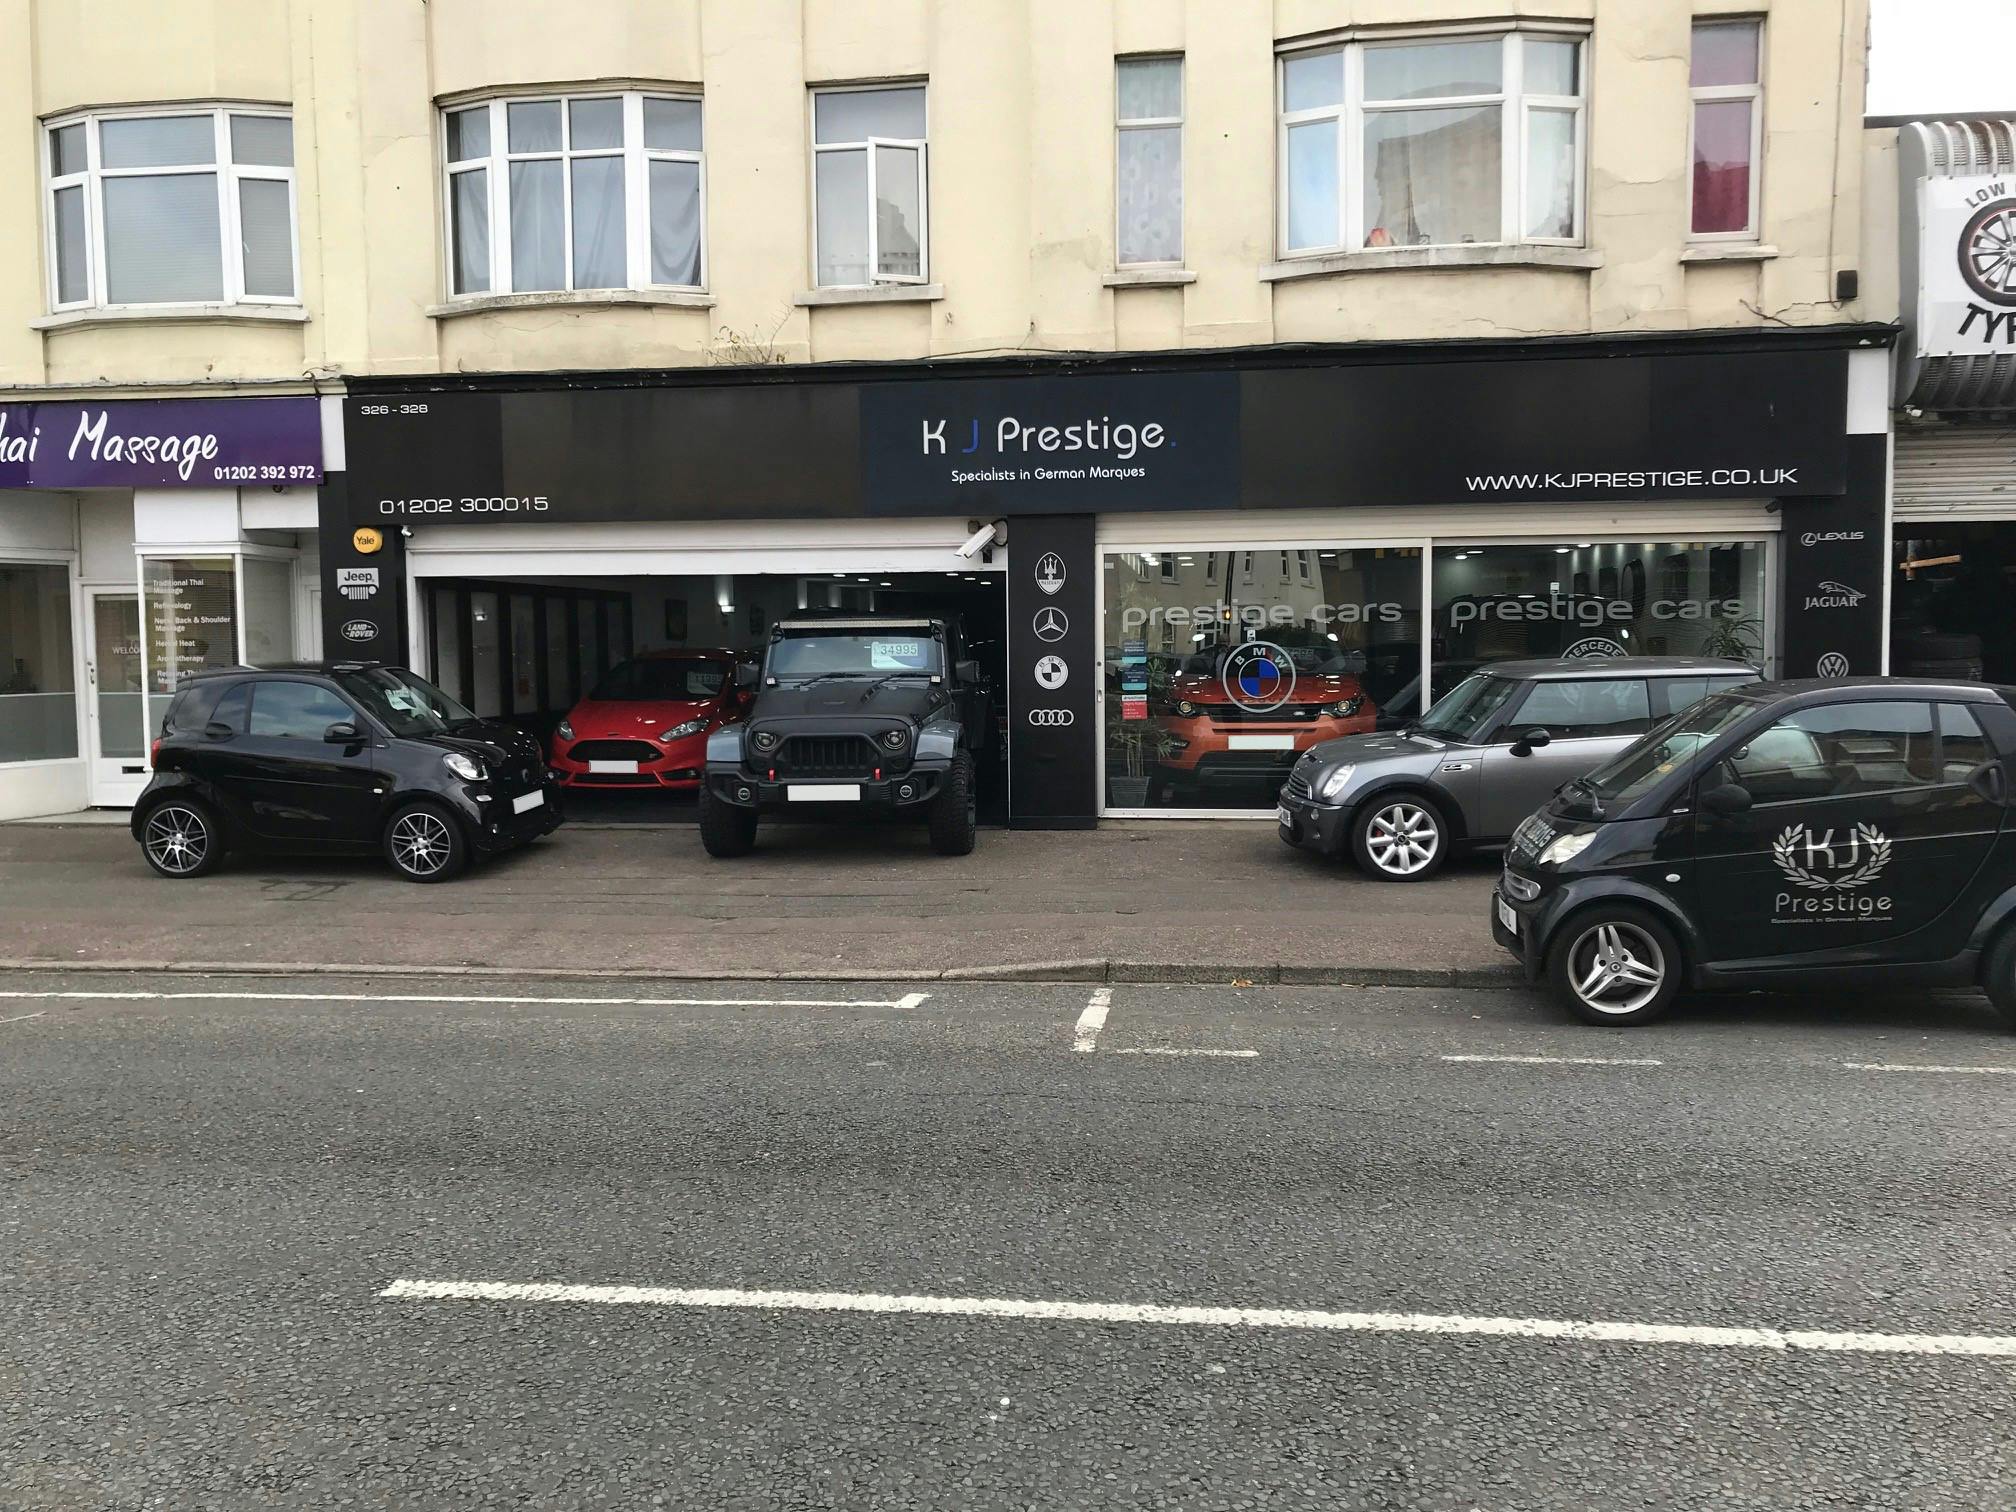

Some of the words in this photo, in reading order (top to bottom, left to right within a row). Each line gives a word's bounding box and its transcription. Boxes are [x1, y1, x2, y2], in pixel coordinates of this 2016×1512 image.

[1965, 182, 2006, 209] LOW
[361, 405, 389, 415] 326
[400, 404, 428, 414] 328
[922, 419, 947, 455] K
[961, 418, 979, 454] J
[68, 410, 219, 481] Massage
[214, 467, 257, 480] 01202
[260, 466, 286, 479] 392
[289, 465, 315, 478] 972
[951, 466, 1016, 485] Specialists
[1019, 468, 1031, 480] in
[1034, 467, 1086, 480] German
[1089, 465, 1146, 481] Marques
[1465, 468, 1799, 491] WWW.KJPRESTIGE.CO.UK
[380, 500, 452, 514] 01202
[460, 497, 549, 512] 300015
[356, 535, 375, 545] Yale
[1817, 531, 1865, 541] LEXUS
[344, 571, 373, 583] Jeep
[1450, 594, 1634, 628] prestige
[1650, 599, 1746, 620] cars
[1804, 596, 1858, 610] JAGUAR
[1122, 598, 1295, 633] prestige
[1310, 601, 1403, 624] cars
[112, 646, 140, 654] WELCO
[880, 645, 918, 656] 34995
[1568, 641, 1622, 658] ERCEDE
[1805, 828, 1858, 869] KJ
[1775, 893, 1892, 916] Prestige
